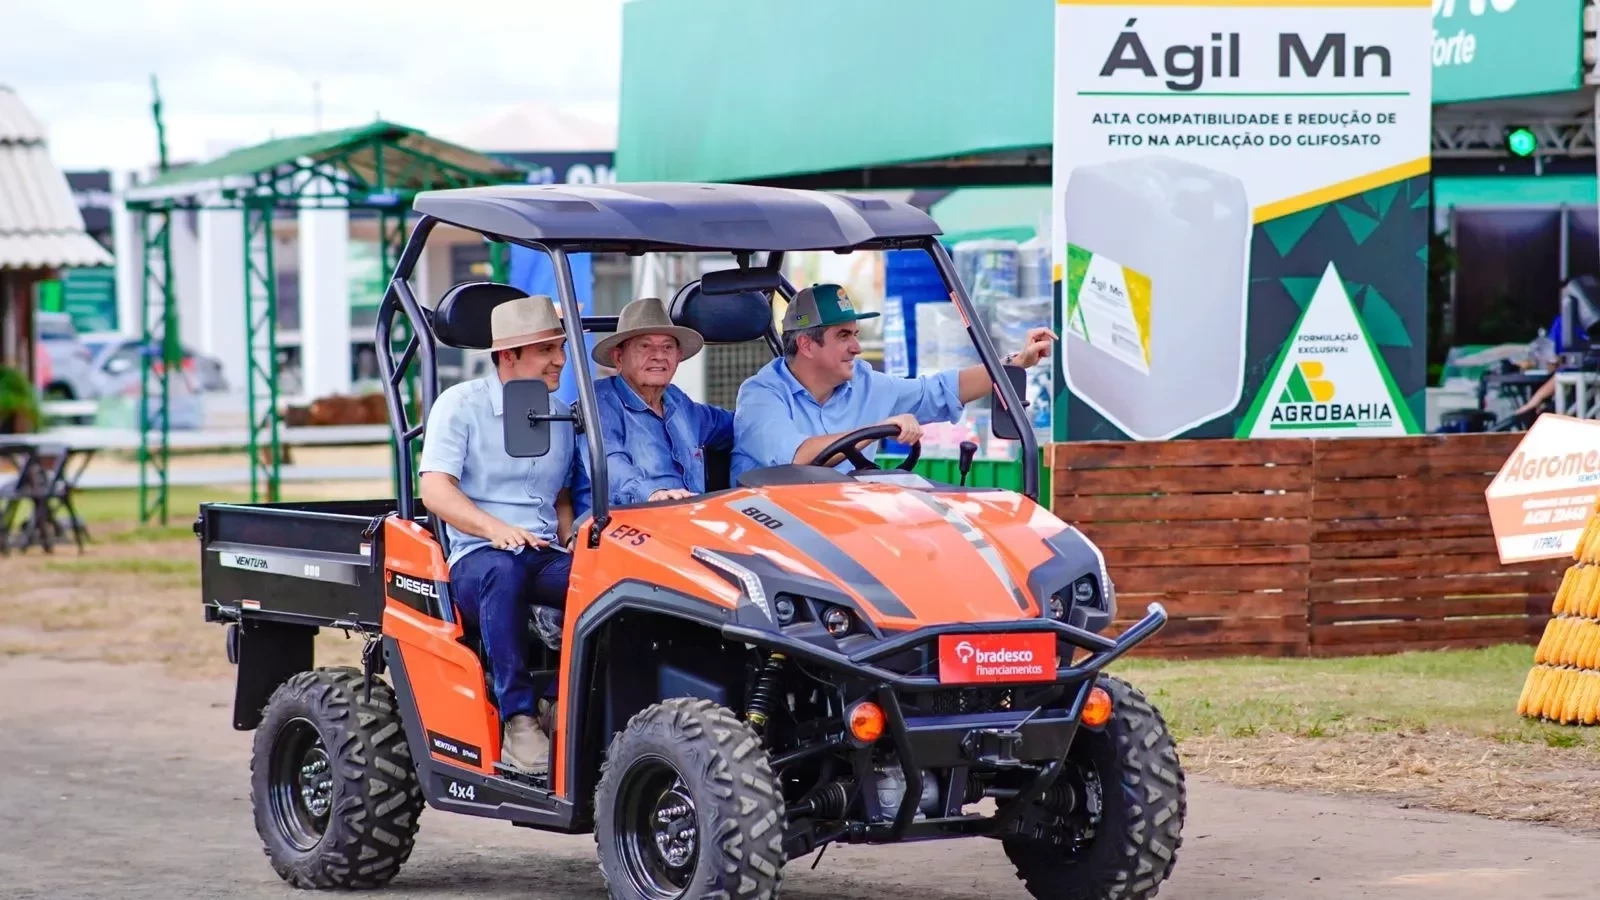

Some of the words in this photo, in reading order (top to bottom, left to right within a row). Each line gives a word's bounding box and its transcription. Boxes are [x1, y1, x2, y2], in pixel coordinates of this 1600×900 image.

[1098, 17, 1240, 92] Ágil
[1278, 32, 1392, 78] Mn
[1092, 113, 1132, 125] ALTA
[1136, 113, 1279, 125] COMPATIBILIDADE
[1284, 113, 1293, 125] E
[1298, 109, 1372, 128] REDUÇÃO
[1376, 113, 1397, 124] DE
[1108, 134, 1143, 146] FITO
[1148, 134, 1170, 146] NA
[1175, 131, 1265, 150] APLICAÇÃO
[1269, 134, 1292, 146] DO
[1297, 134, 1381, 146] GLIFOSATO
[1298, 332, 1359, 343] FORMULAÇÃO
[1298, 346, 1349, 354] EXCLUSIVA:
[1271, 403, 1392, 422] AGROBAHIA
[741, 506, 784, 530] 800
[609, 524, 651, 546] EPS
[234, 555, 269, 569] VENTURA
[395, 574, 440, 599] DIESEL
[975, 648, 1033, 663] bradesco
[976, 664, 1043, 676] financiamentos
[433, 738, 458, 754] VENTURA
[448, 781, 475, 801] 4x4
